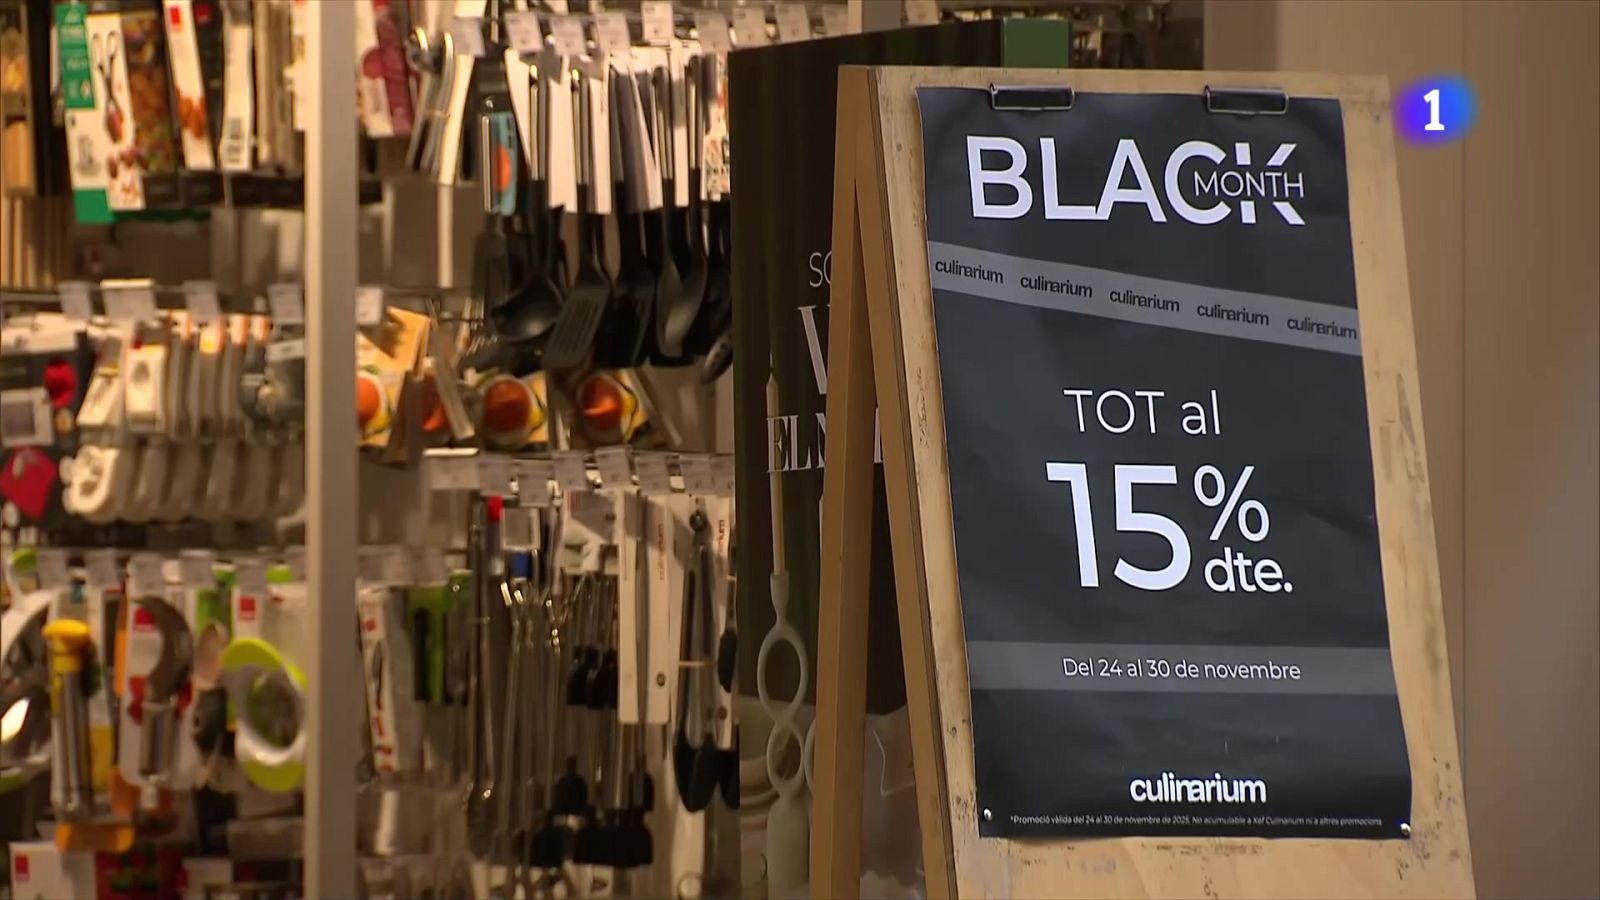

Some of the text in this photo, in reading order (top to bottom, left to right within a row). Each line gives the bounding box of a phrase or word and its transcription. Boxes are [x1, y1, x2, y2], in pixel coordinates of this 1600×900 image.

[966, 135, 1306, 226] BLACK
[1194, 170, 1305, 199] MONTH
[935, 259, 1358, 340] culinarium culinarium culinarium culinarium culinarium
[1063, 389, 1221, 435] TOT al
[1204, 546, 1293, 592] dte.
[1063, 657, 1301, 680] Del 24 al 30 de novembre
[1129, 772, 1267, 804] culinarium
[1073, 815, 1084, 824] del
[1086, 815, 1094, 824] 24
[1096, 815, 1102, 824] al
[1103, 815, 1112, 824] 30
[1114, 815, 1123, 824] de
[1125, 815, 1160, 824] novembre
[1162, 815, 1171, 824] de
